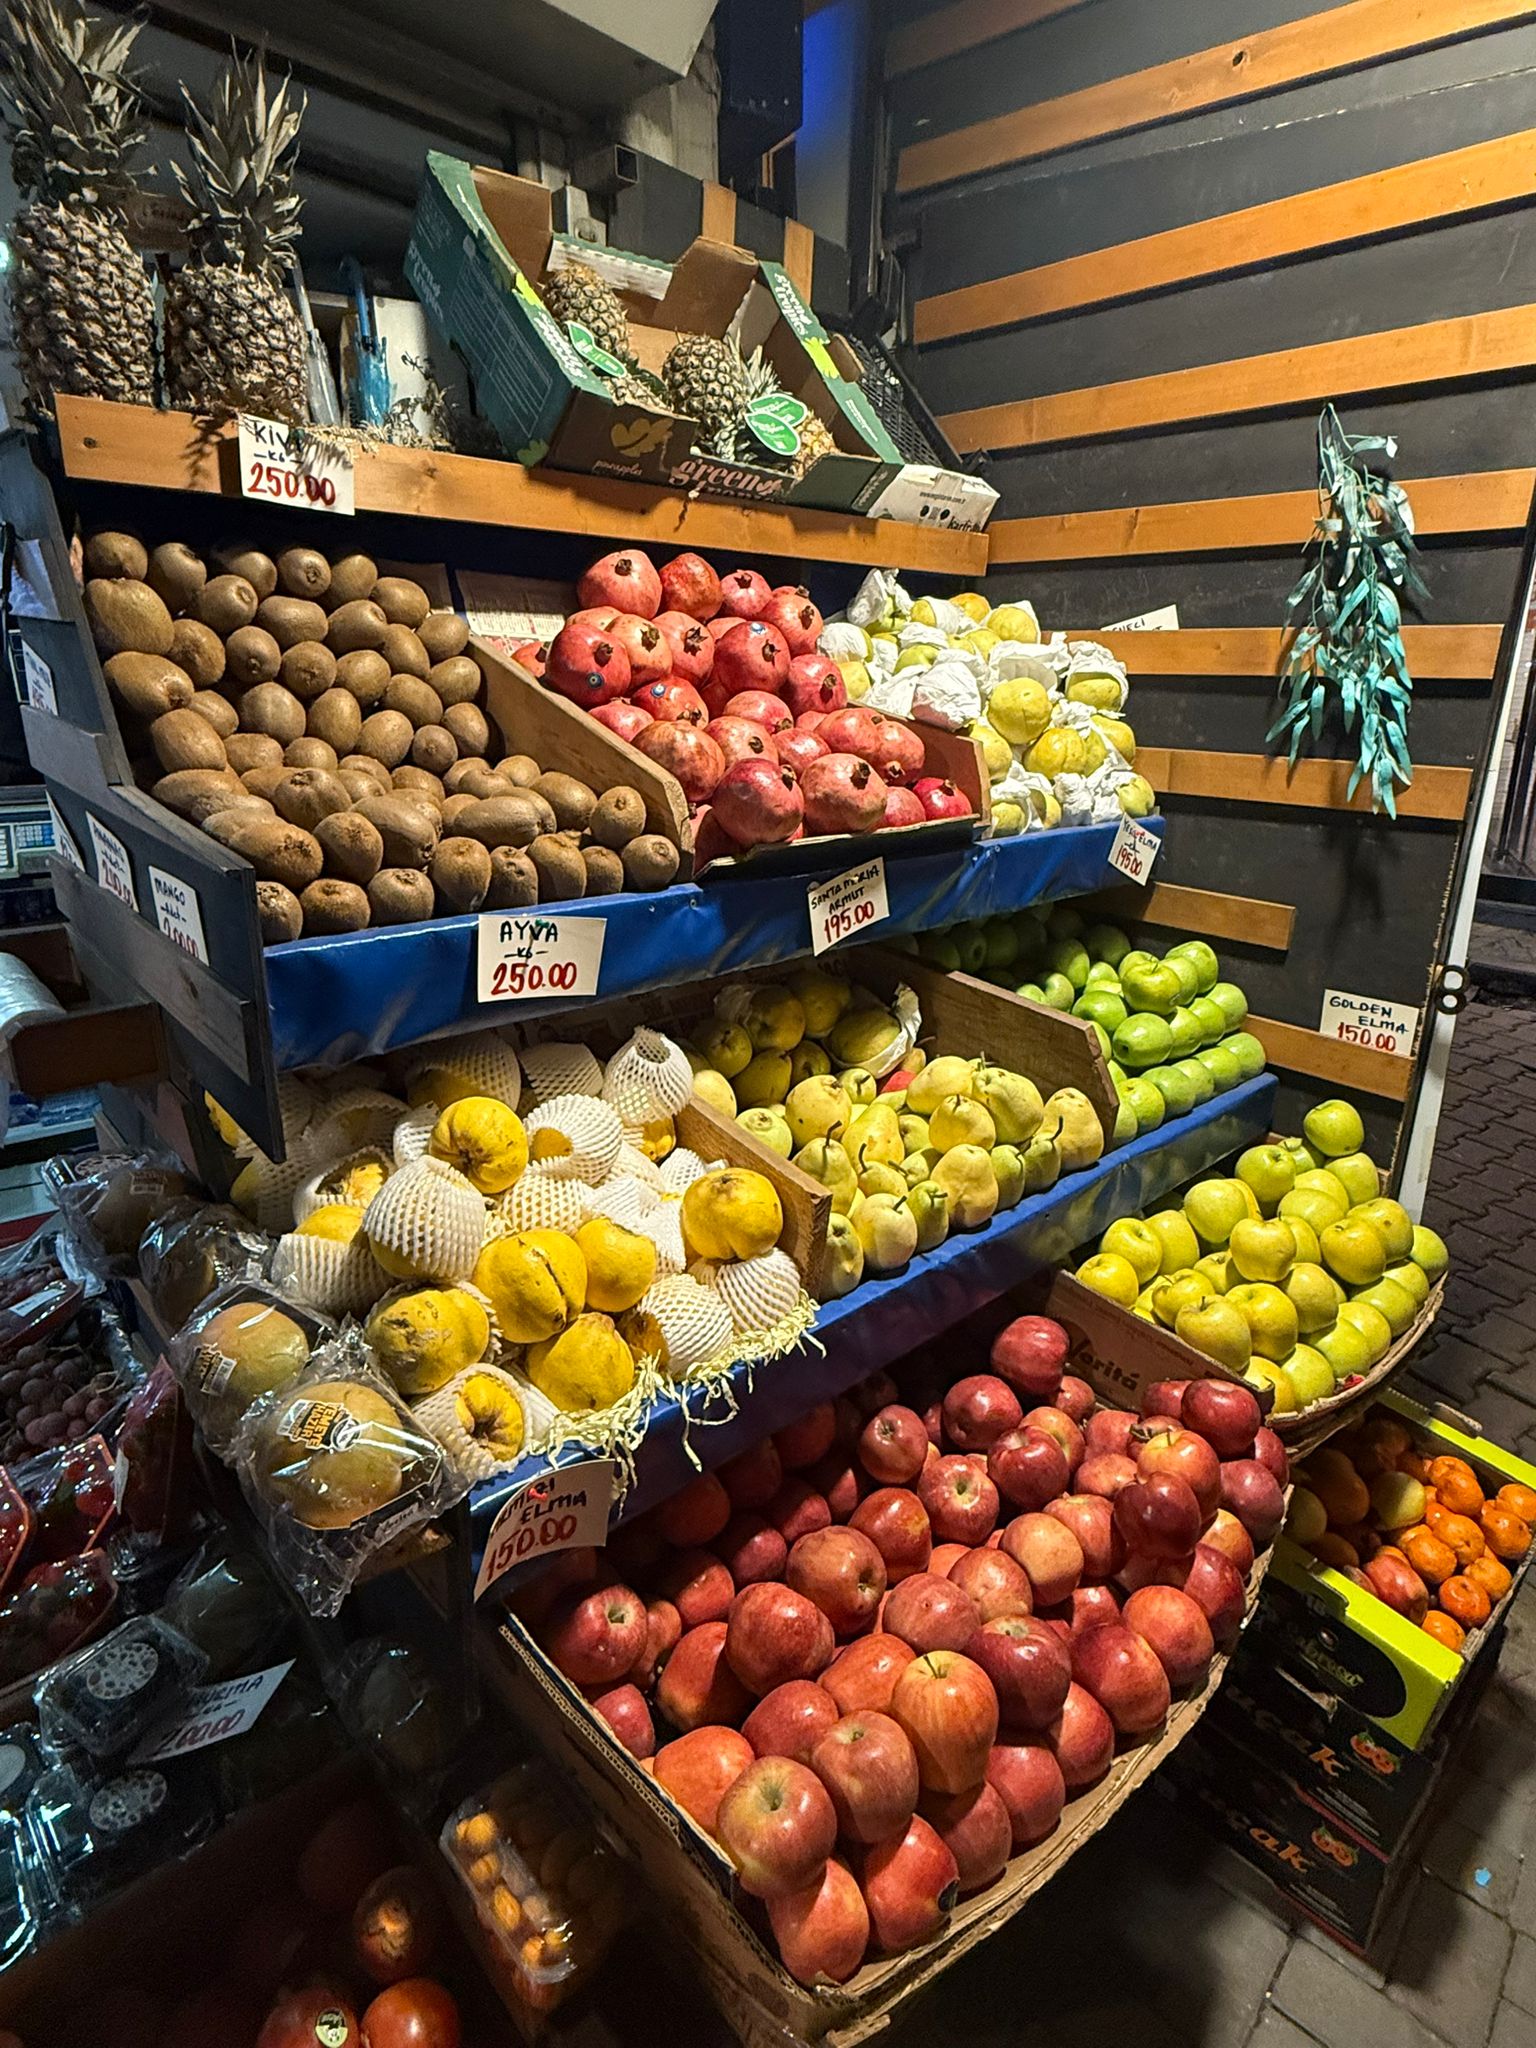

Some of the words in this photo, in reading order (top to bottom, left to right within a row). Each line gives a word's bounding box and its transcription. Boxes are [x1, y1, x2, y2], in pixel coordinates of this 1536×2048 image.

[248, 462, 336, 506] 250.00
[669, 459, 763, 492] green
[154, 877, 186, 906] MANGO
[811, 884, 842, 909] SANTA
[828, 887, 865, 915] ARMUT
[500, 920, 558, 942] AYVA
[824, 901, 874, 944] 195.00
[491, 962, 577, 995] 250.00
[1329, 996, 1392, 1018] GOLDEN
[1337, 1022, 1396, 1052] 150.00
[1358, 1015, 1409, 1035] ELMA
[521, 1490, 588, 1525] ELMA
[487, 1515, 577, 1581] 150.00
